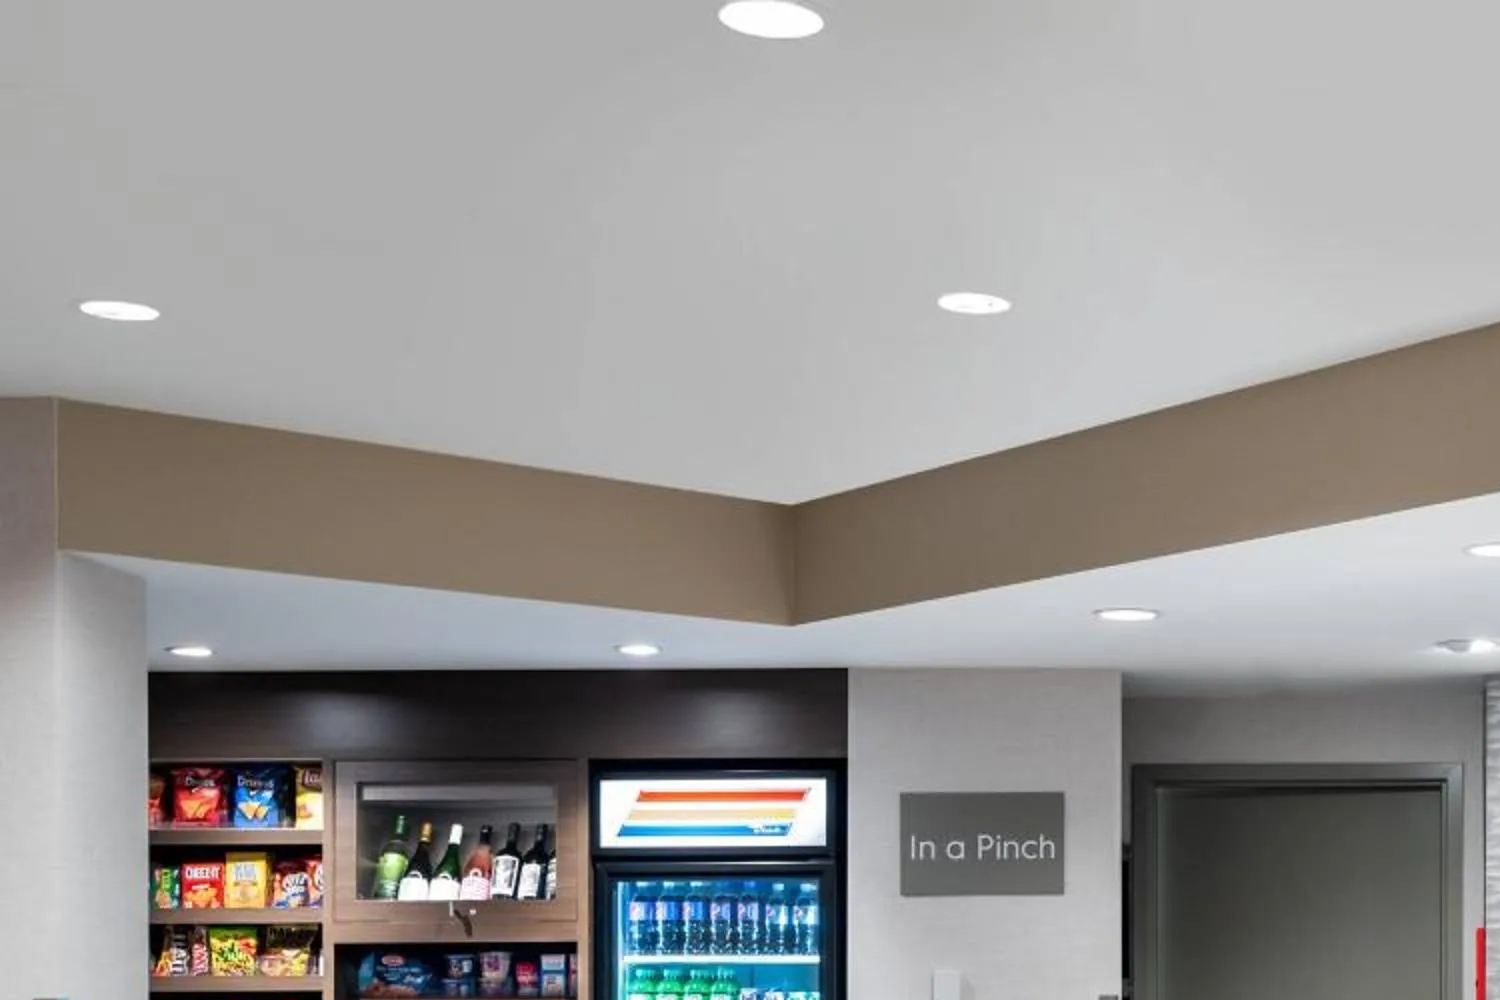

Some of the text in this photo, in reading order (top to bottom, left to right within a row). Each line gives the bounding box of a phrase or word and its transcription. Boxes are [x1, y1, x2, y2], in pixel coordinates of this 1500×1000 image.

[911, 833, 1056, 861] In a Pinch
